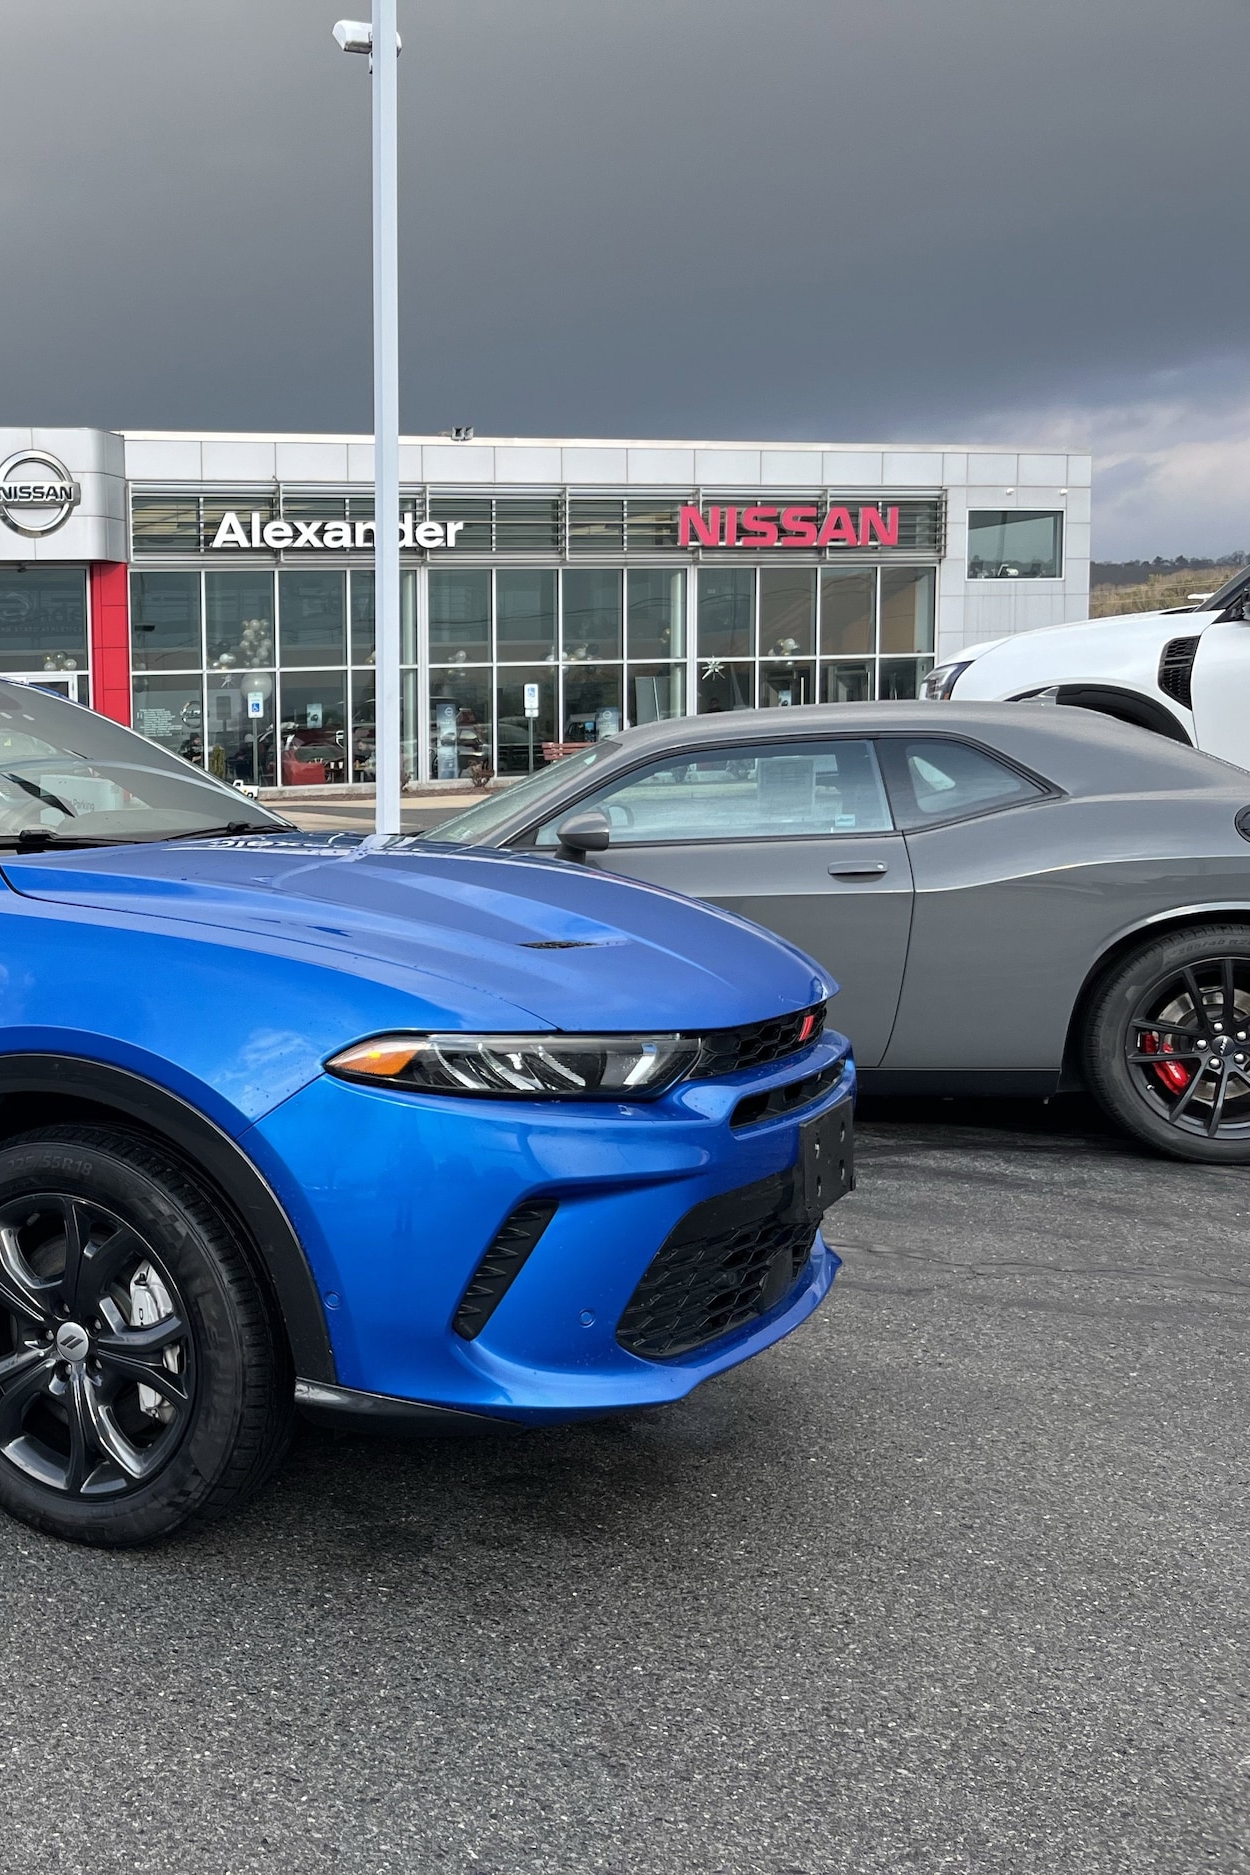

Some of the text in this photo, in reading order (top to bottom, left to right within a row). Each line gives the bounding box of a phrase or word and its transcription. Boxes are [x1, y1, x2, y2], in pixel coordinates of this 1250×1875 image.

[212, 511, 464, 549] Alexander
[678, 505, 899, 547] NISSAN
[73, 798, 95, 811] Parking
